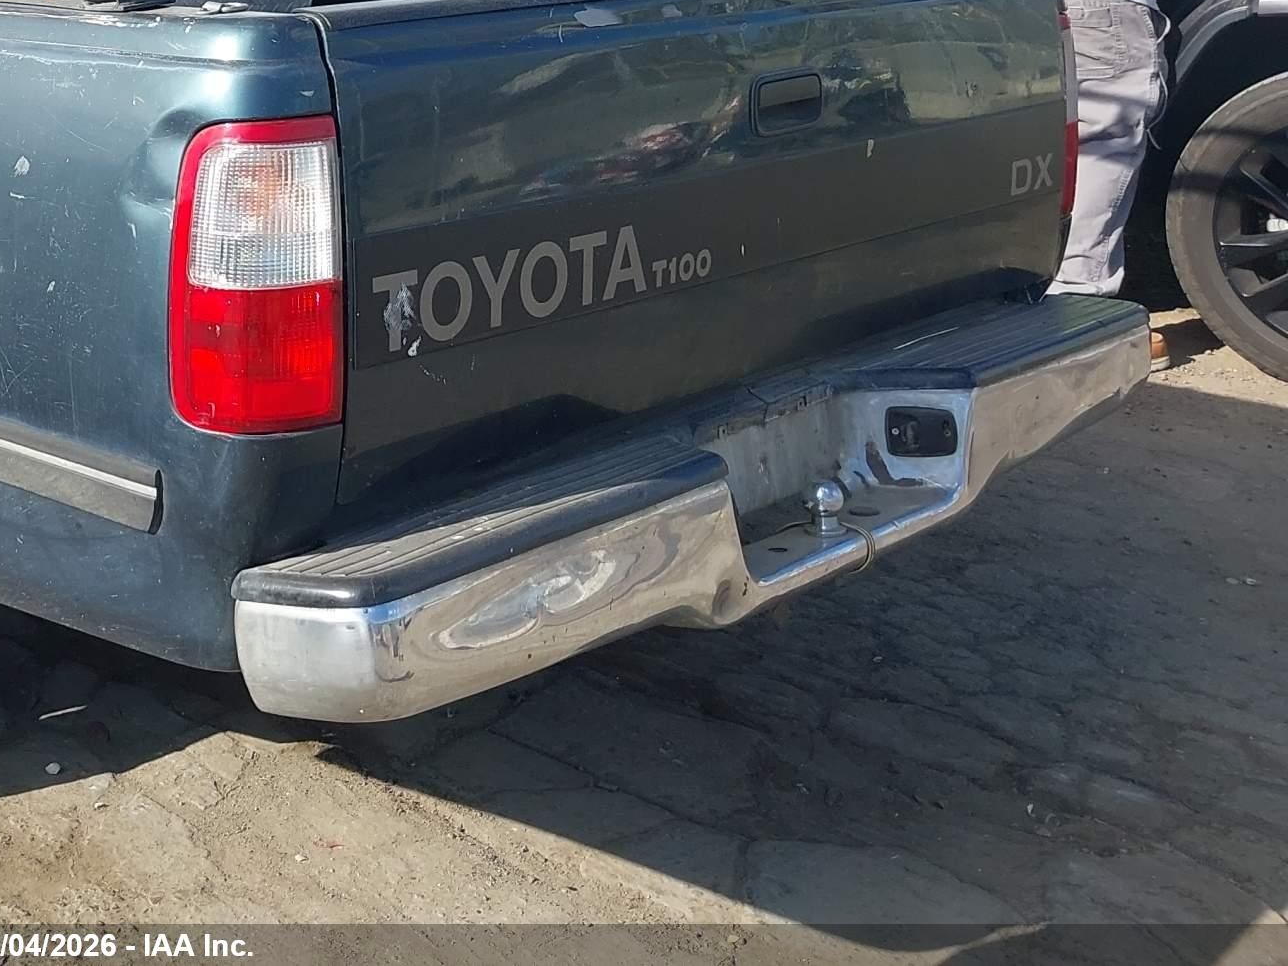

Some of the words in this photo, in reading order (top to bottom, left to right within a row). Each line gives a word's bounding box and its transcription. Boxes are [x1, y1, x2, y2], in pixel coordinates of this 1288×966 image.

[1011, 152, 1054, 196] DX
[373, 224, 647, 353] TOYOTA
[652, 248, 712, 288] T100
